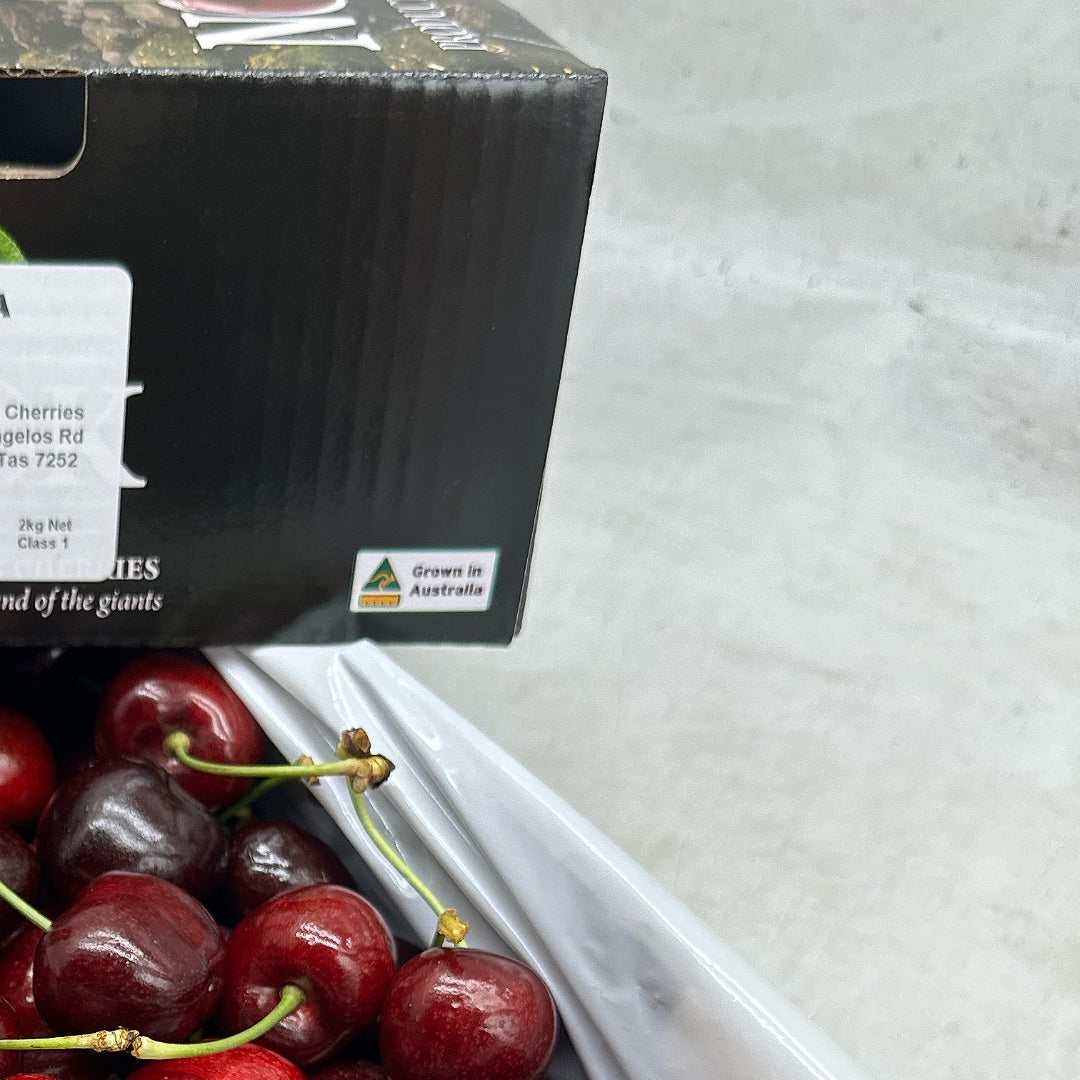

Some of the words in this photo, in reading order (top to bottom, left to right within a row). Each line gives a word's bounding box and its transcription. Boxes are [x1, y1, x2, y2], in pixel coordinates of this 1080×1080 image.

[5, 404, 84, 421] Cherries
[60, 429, 84, 445] Rd
[35, 452, 78, 469] 7252
[18, 517, 44, 534] 2kg
[48, 518, 73, 532] Net
[18, 537, 56, 551] Class
[60, 537, 70, 550] 1
[412, 565, 462, 578] Grown
[467, 565, 482, 578] in
[409, 584, 483, 597] Australia
[34, 586, 61, 618] of
[60, 586, 95, 611] the
[95, 588, 164, 619] giants
